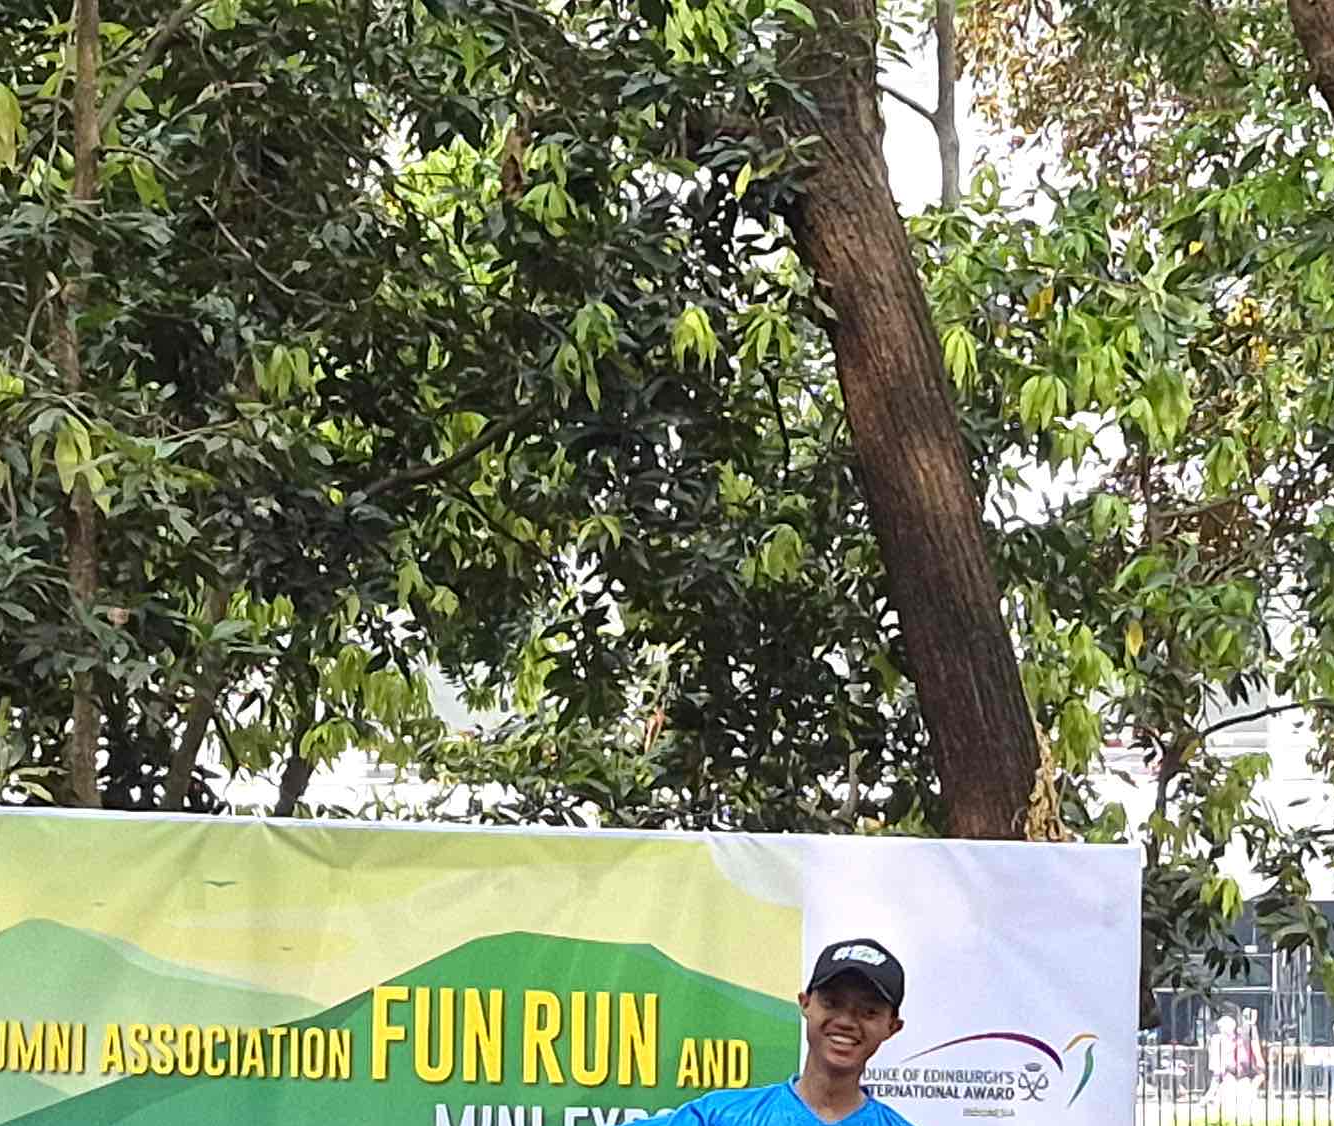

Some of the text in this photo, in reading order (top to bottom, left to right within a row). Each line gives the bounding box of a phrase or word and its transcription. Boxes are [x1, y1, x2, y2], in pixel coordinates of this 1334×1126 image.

[100, 1023, 352, 1080] ASSOCIATION
[371, 985, 504, 1083] FUN
[522, 989, 658, 1088] RUN
[677, 1038, 750, 1090] AND
[862, 1067, 1015, 1085] DUKE OF EDINBURGH'S
[868, 1083, 1015, 1101] TERNATIONAL AWARD
